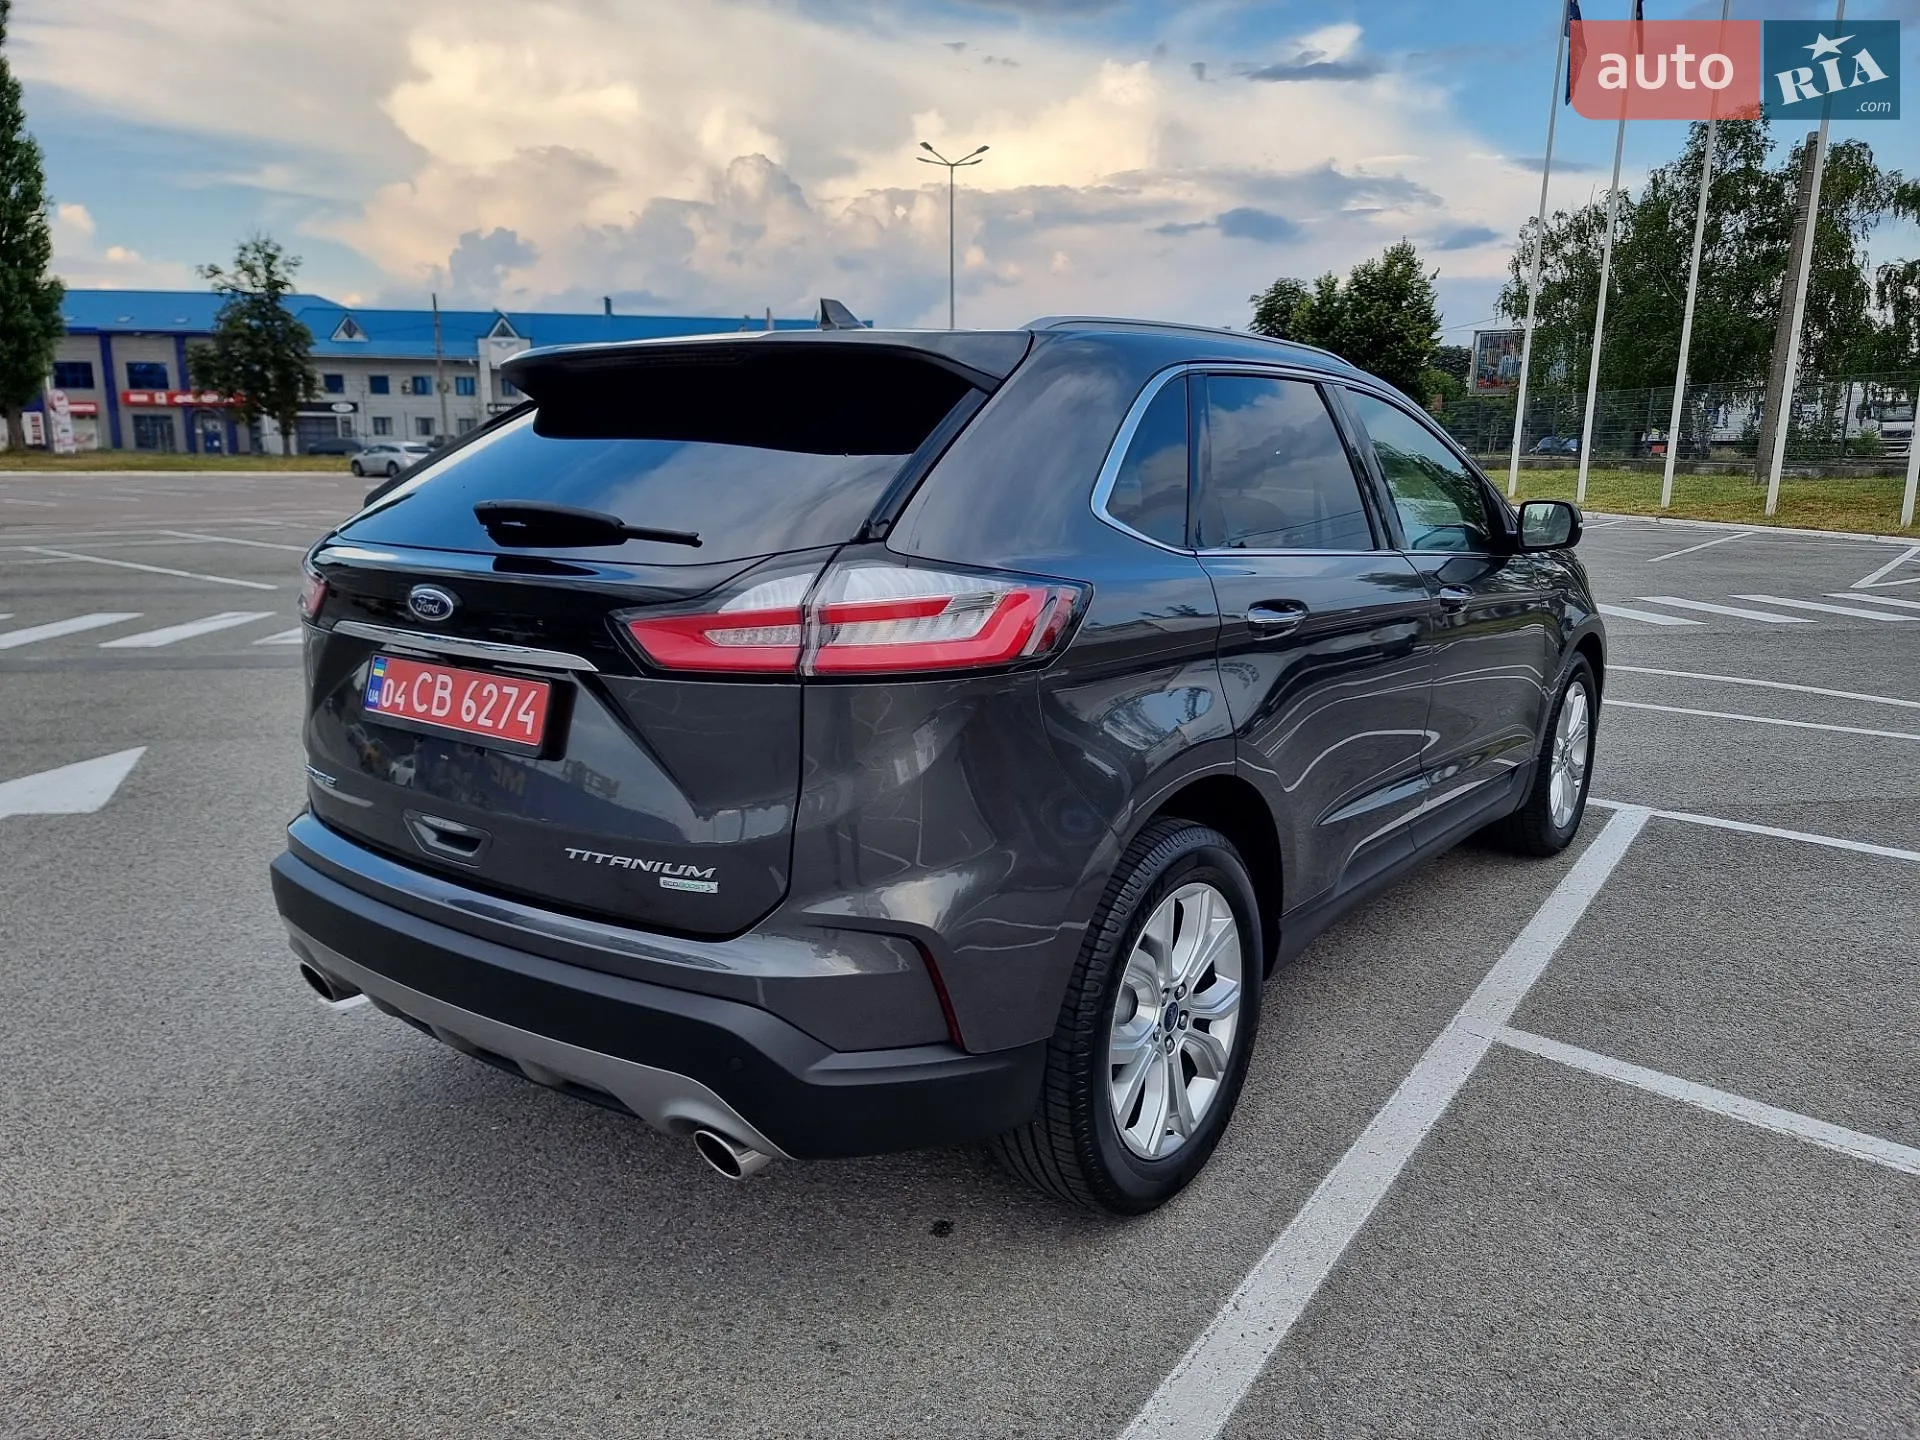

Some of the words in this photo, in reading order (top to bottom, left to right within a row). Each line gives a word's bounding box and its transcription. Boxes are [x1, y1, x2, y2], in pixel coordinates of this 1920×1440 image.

[367, 689, 379, 703] UA
[381, 678, 407, 711] 04
[412, 671, 453, 717] CB
[461, 680, 538, 735] 6274
[564, 847, 717, 879] TITANIUM
